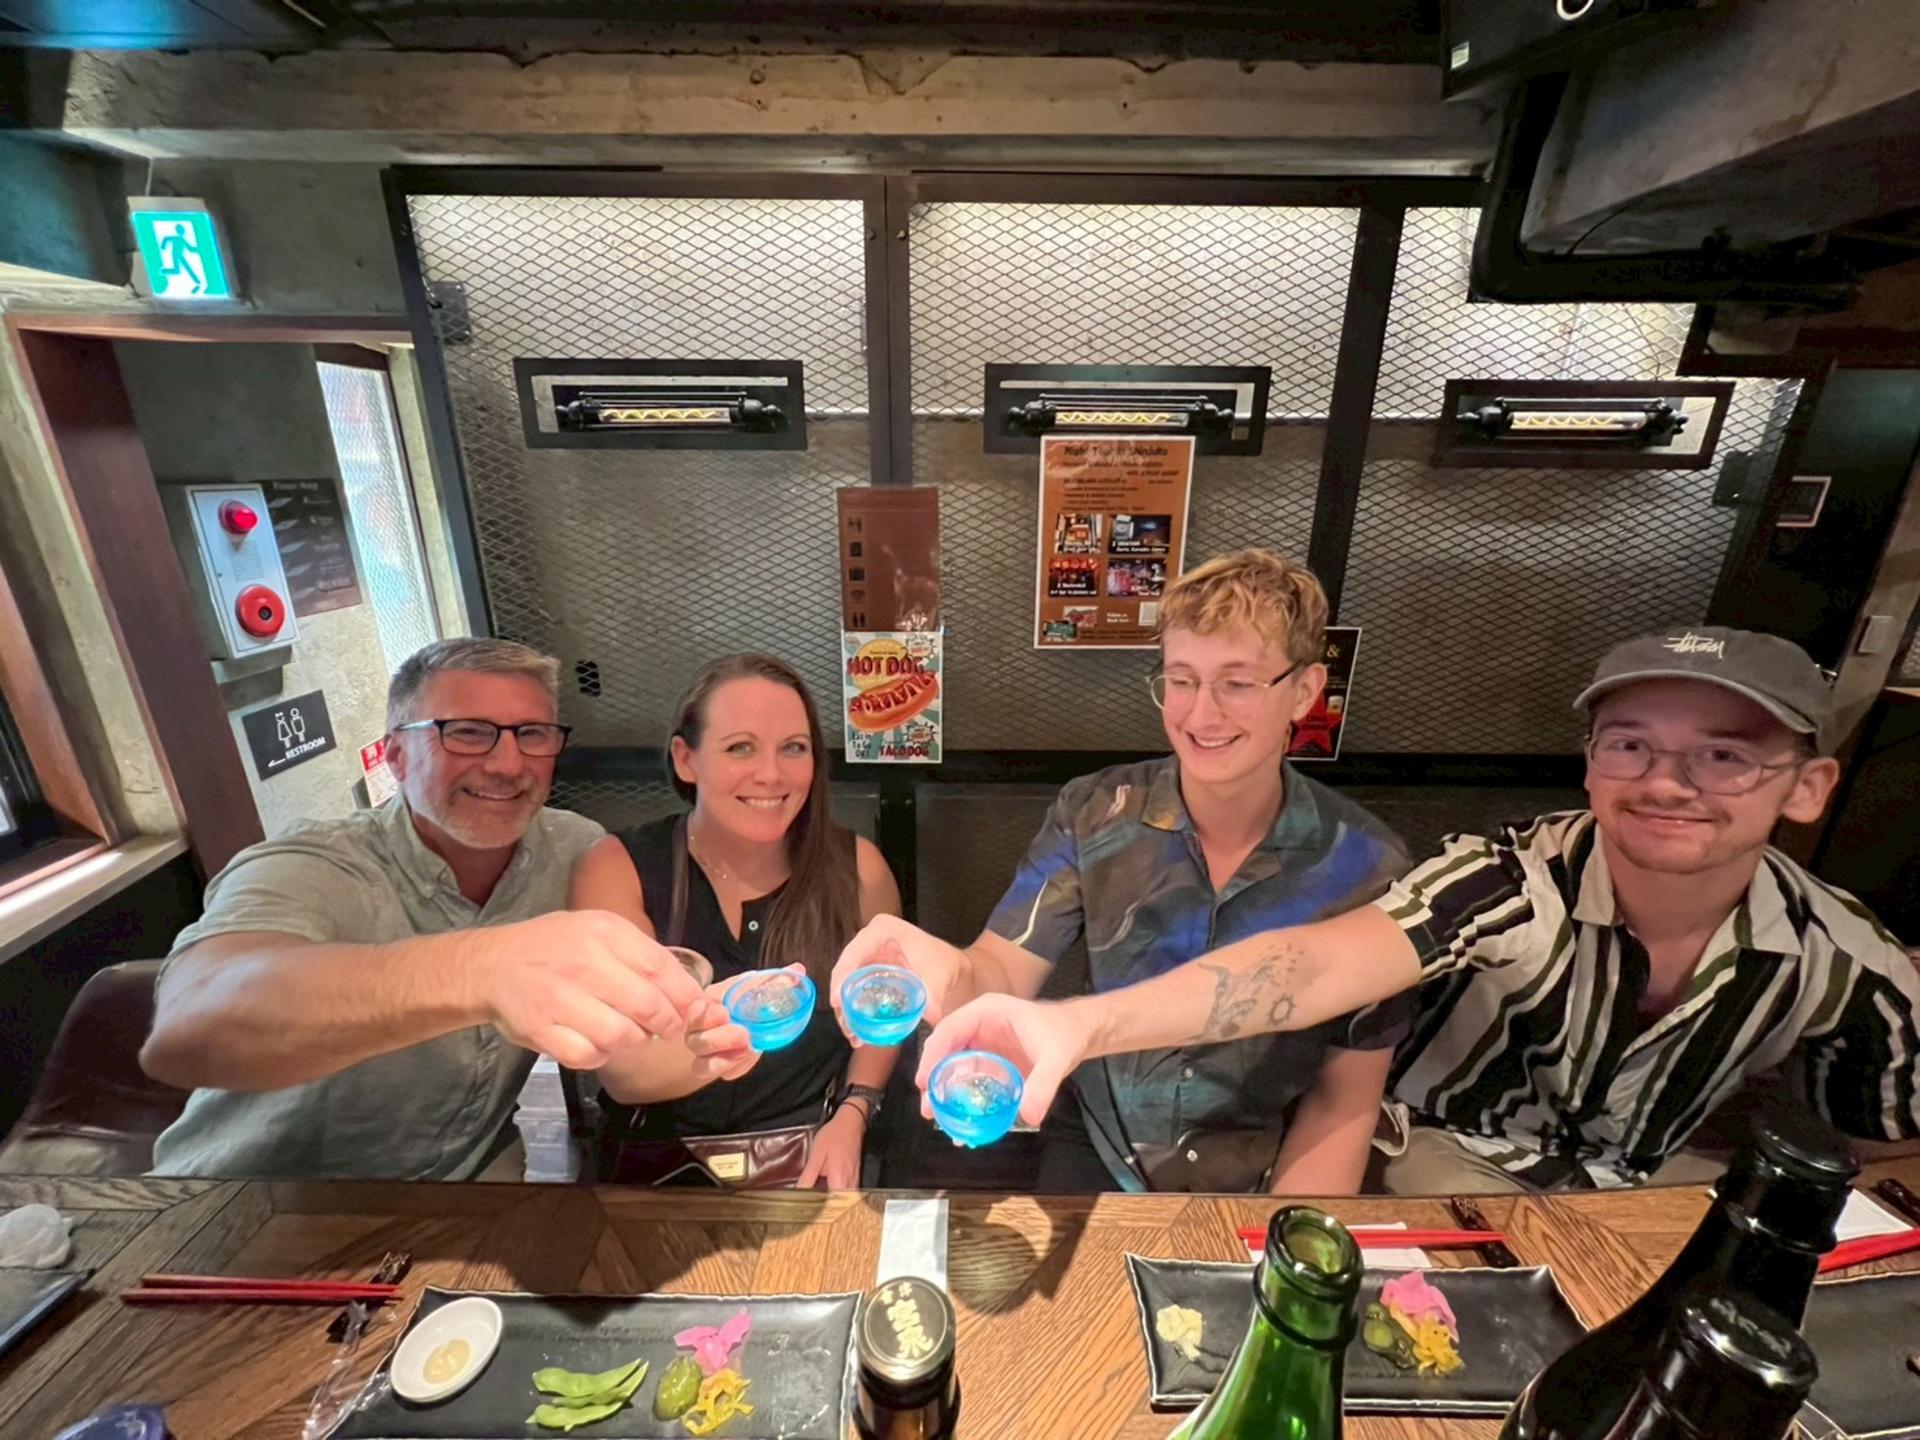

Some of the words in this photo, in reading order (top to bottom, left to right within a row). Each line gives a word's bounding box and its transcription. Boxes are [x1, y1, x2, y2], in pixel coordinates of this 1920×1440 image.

[847, 655, 884, 676] HOT
[886, 655, 924, 676] DOG
[285, 736, 326, 760] RESTROOM
